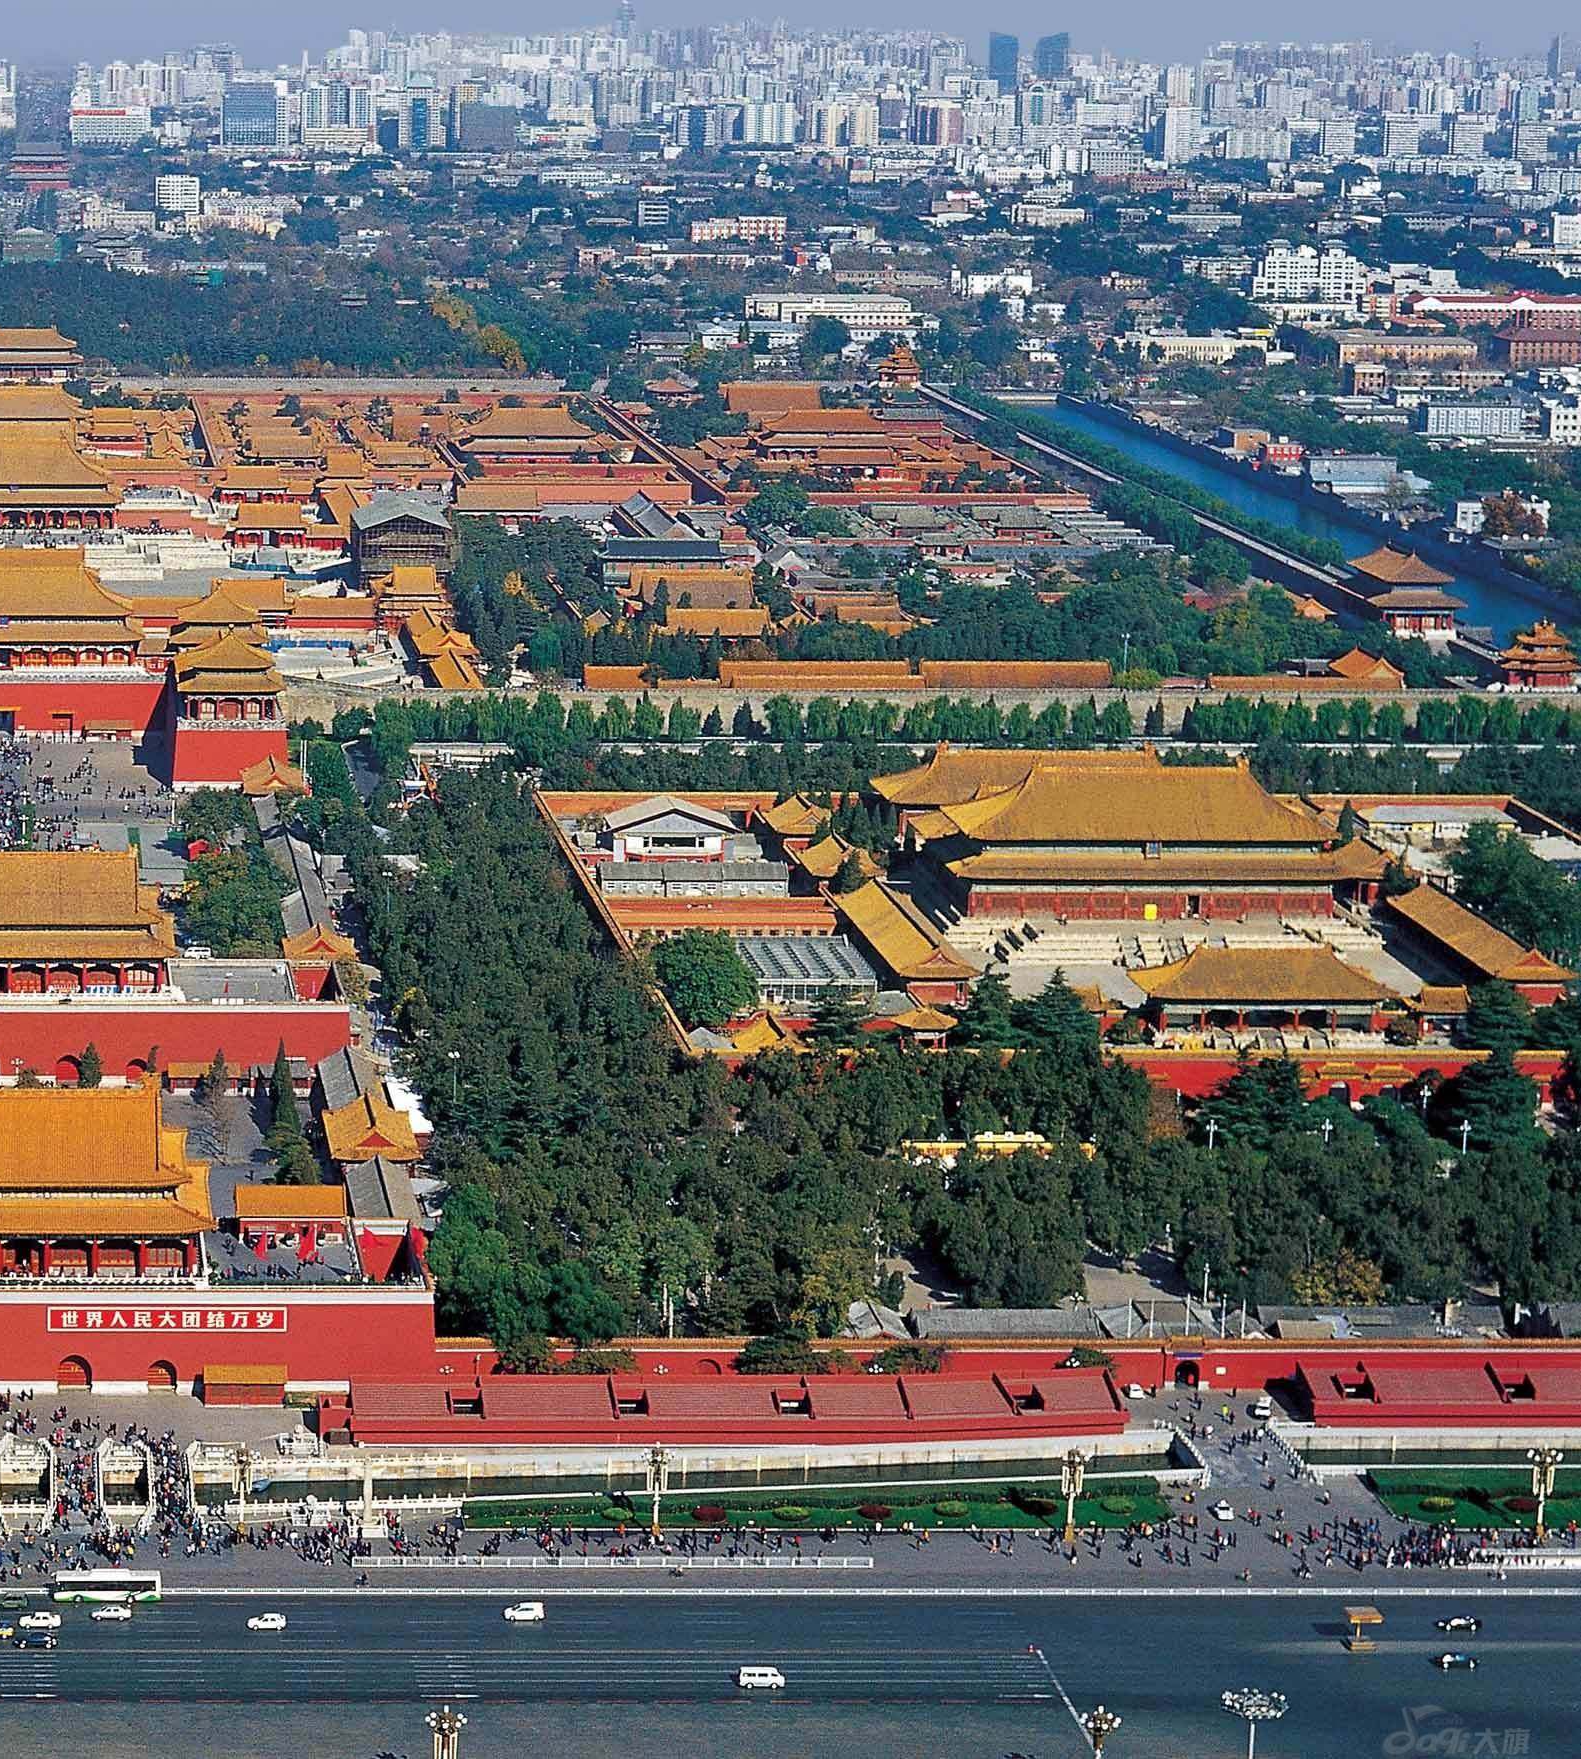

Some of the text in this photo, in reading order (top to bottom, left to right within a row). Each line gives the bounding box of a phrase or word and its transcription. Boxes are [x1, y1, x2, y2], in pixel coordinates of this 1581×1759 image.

[61, 1310, 274, 1329] 世界人民大团结万岁
